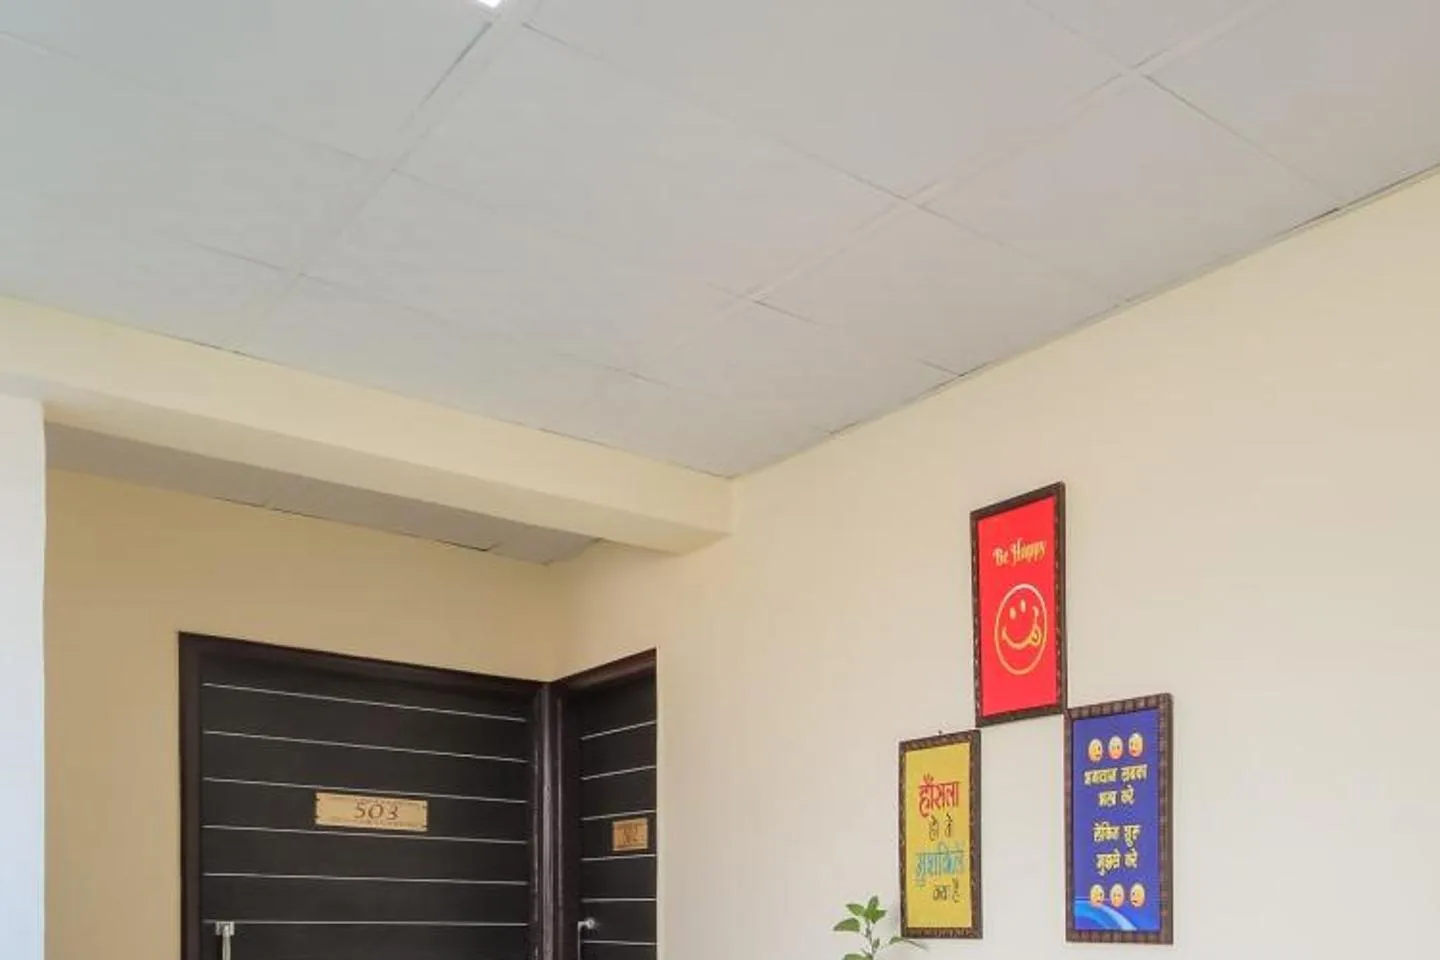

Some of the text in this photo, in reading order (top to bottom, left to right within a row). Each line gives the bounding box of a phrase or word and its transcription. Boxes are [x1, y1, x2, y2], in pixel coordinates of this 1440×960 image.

[992, 537, 1048, 567] Be Happy
[354, 802, 399, 821] 503
